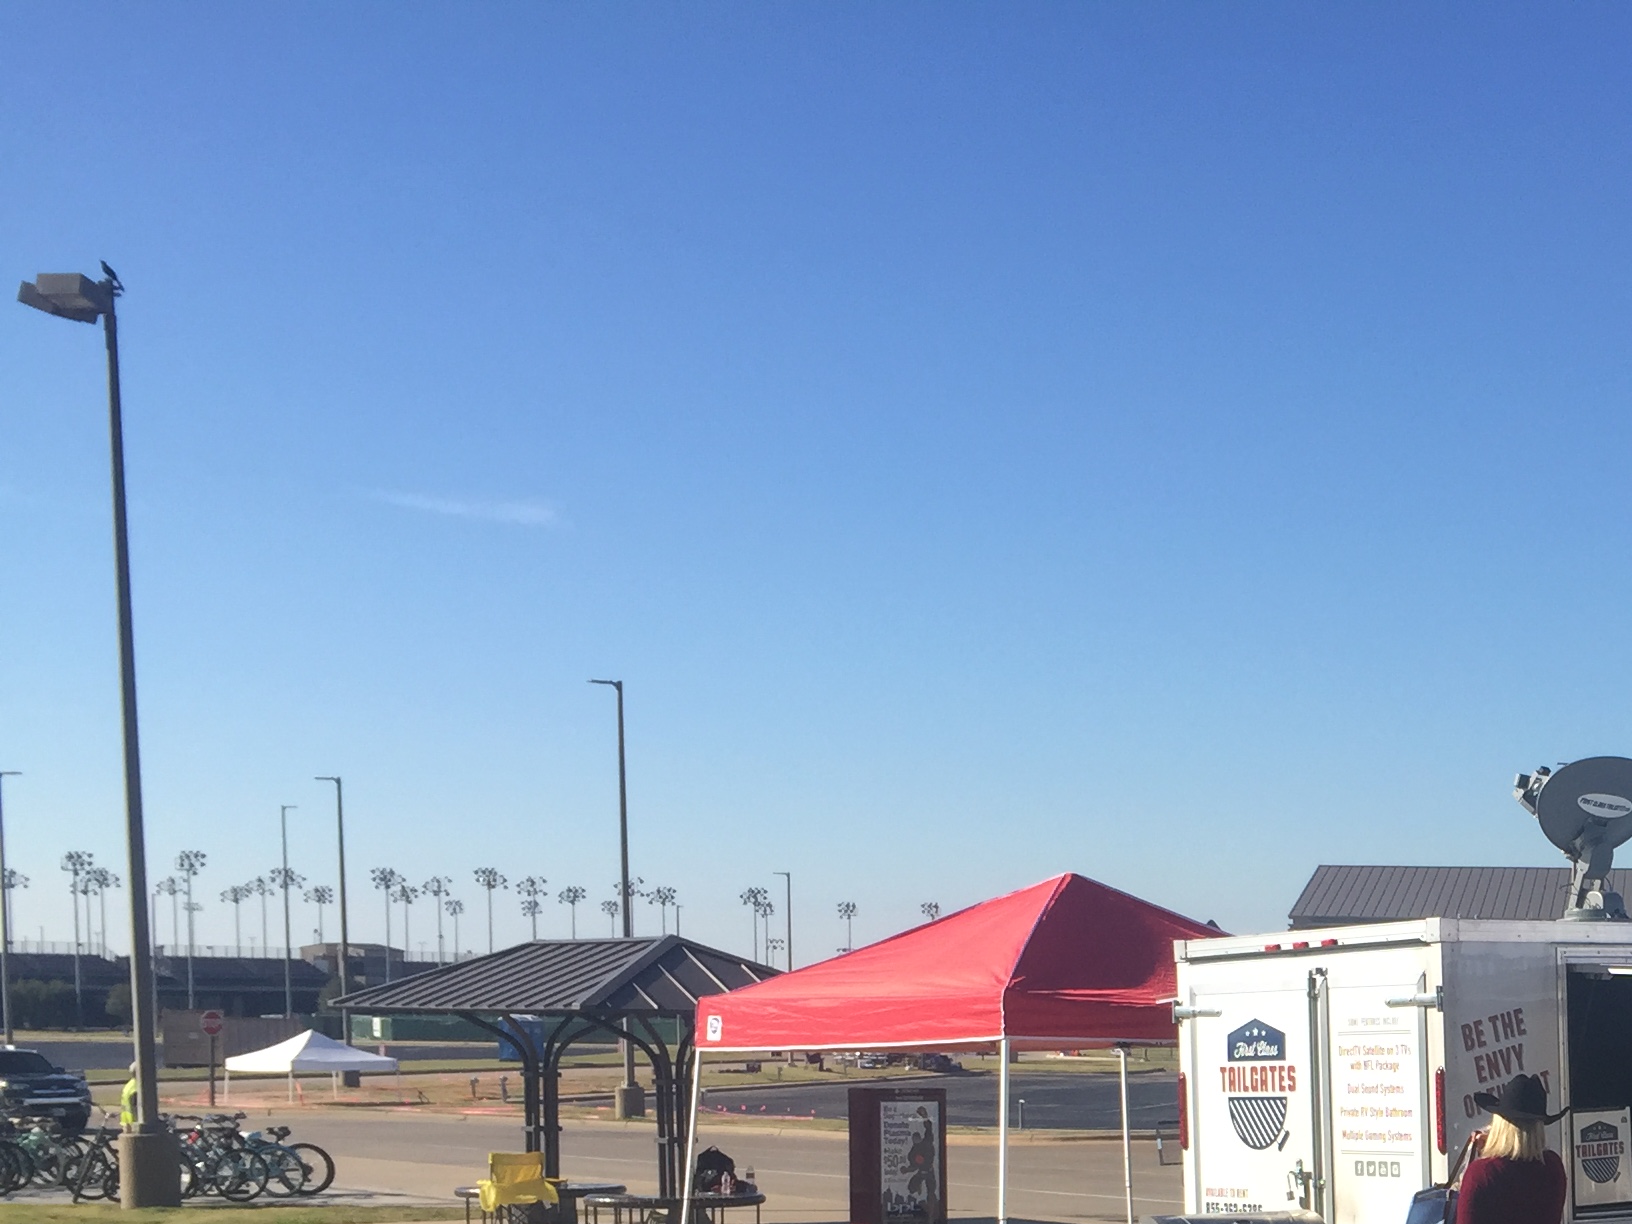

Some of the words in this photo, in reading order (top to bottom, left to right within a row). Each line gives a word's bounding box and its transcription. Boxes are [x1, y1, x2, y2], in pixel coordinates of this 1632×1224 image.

[1461, 1019, 1487, 1052] BE
[1488, 1008, 1527, 1043] THE
[1220, 1065, 1297, 1092] TAILGATES
[1474, 1043, 1525, 1084] ENVY
[1575, 1141, 1625, 1158] TAILGATES
